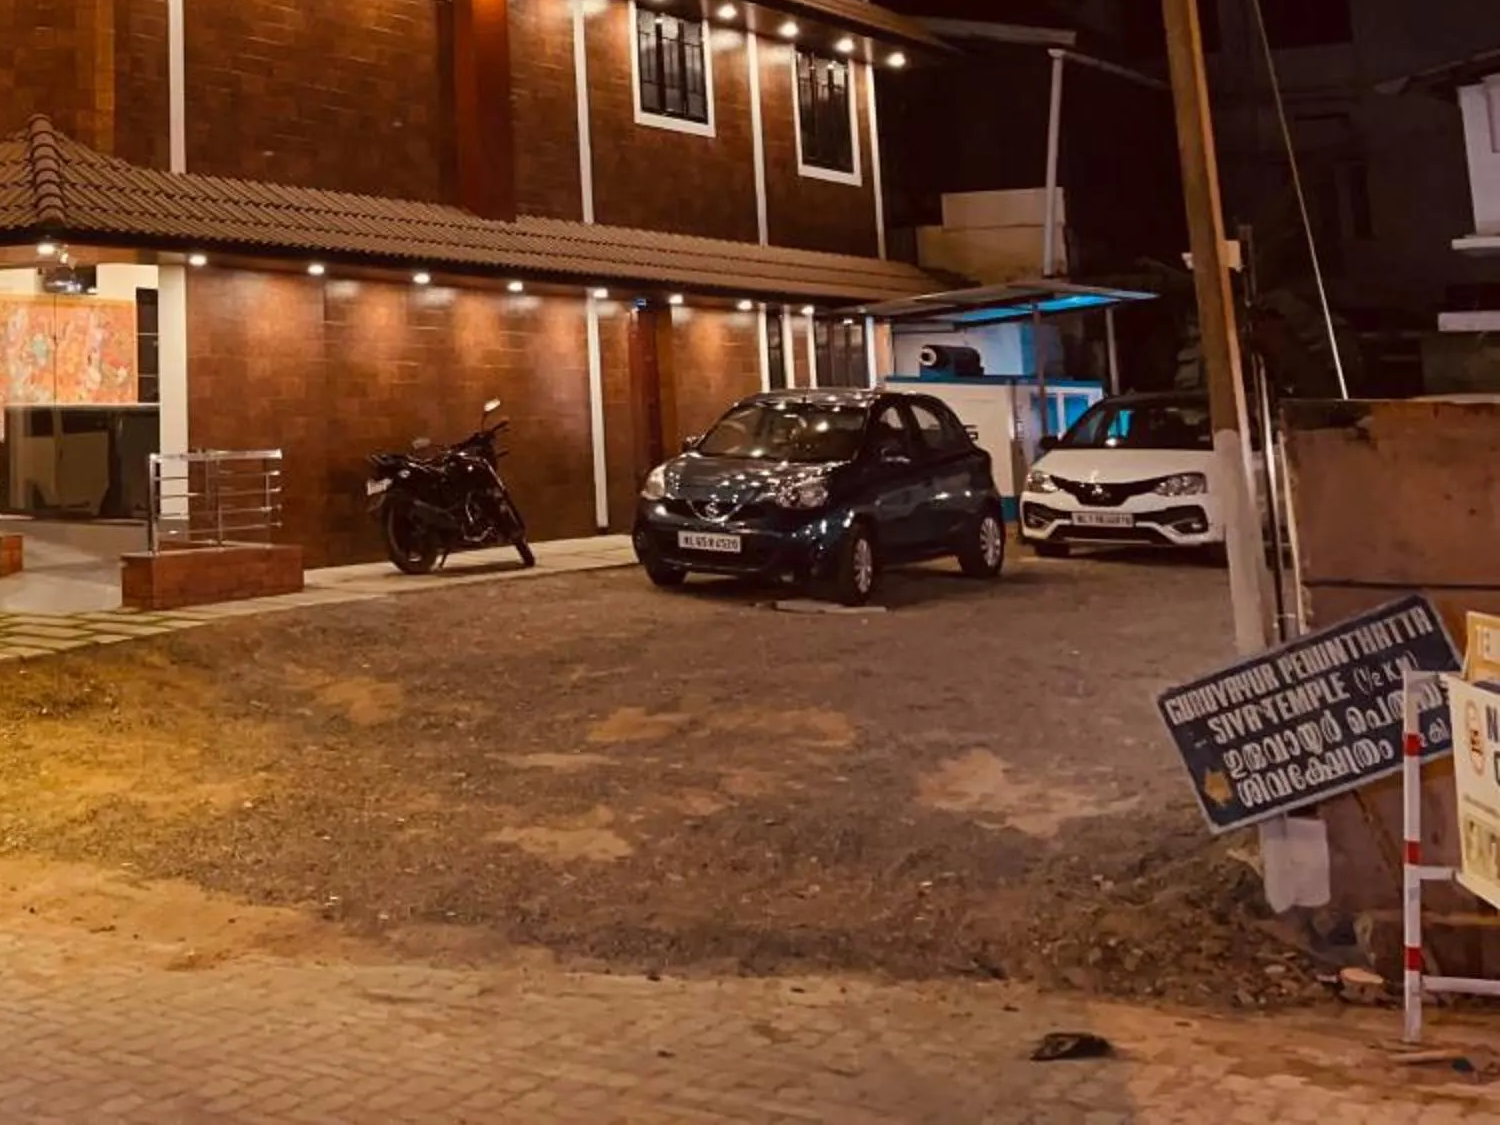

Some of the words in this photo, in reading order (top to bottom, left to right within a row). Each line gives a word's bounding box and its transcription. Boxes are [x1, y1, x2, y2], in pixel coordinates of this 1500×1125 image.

[1164, 664, 1279, 725] GURUVAYUR
[1207, 704, 1264, 745] SIVA
[1262, 672, 1351, 724] TEMPLE
